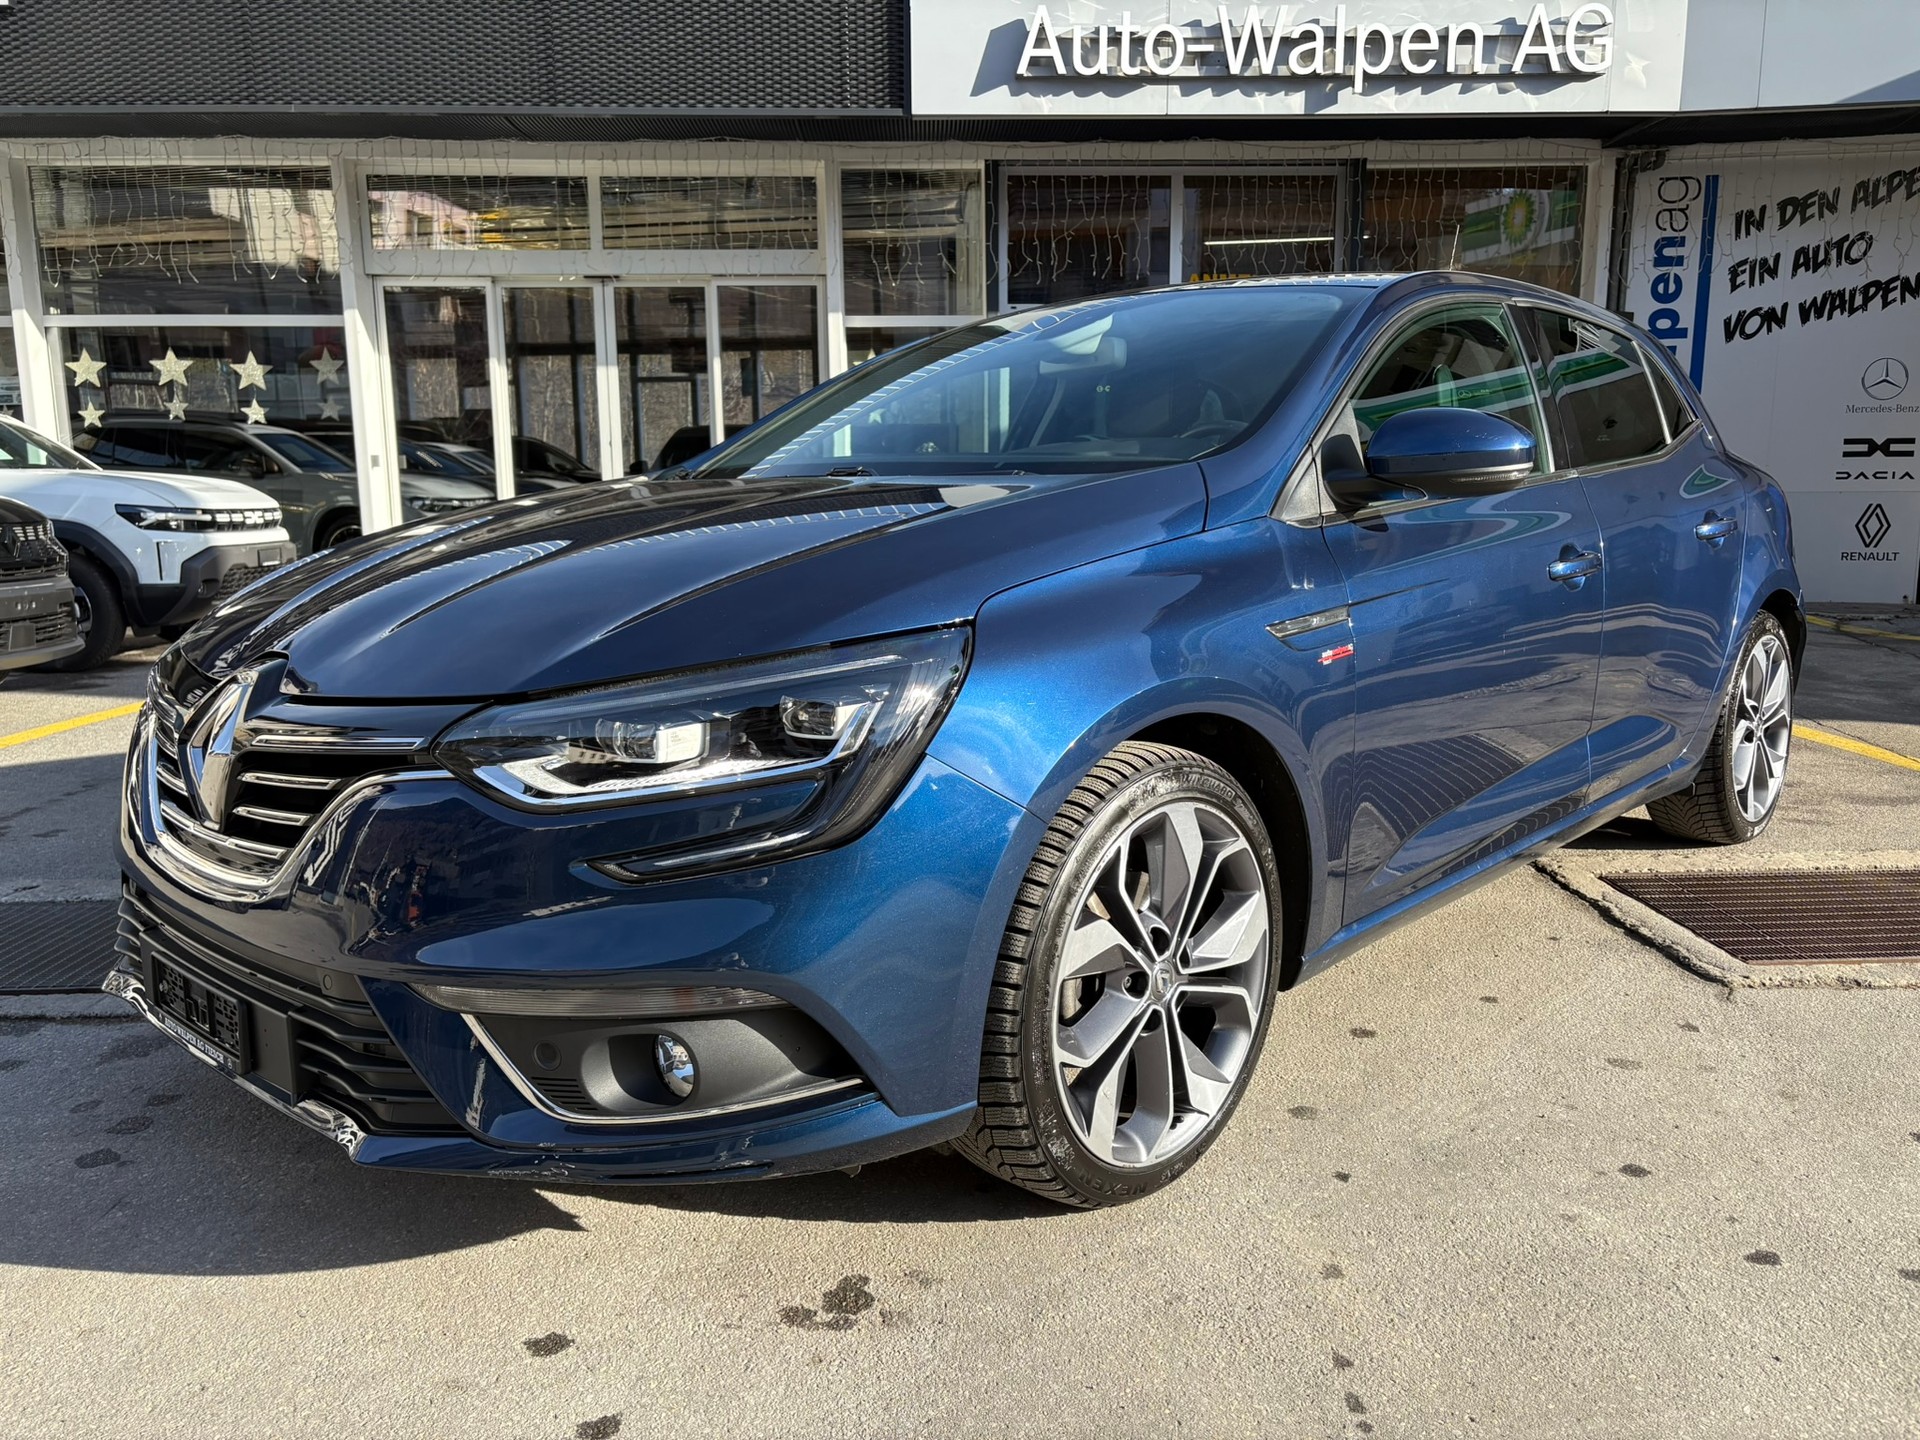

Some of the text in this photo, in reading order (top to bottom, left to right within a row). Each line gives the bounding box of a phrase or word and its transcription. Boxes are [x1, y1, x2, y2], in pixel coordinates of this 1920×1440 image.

[1016, 2, 1614, 93] Auto-Walpen AG
[1734, 204, 1767, 241] IN
[1776, 186, 1841, 231] DEN
[1727, 231, 1874, 294] EIN AUTO
[1723, 271, 1920, 344] VON WALPEN
[1844, 403, 1920, 414] Mercedes-Benz
[1835, 470, 1916, 480] DACIA
[1840, 551, 1901, 562] RENAULT
